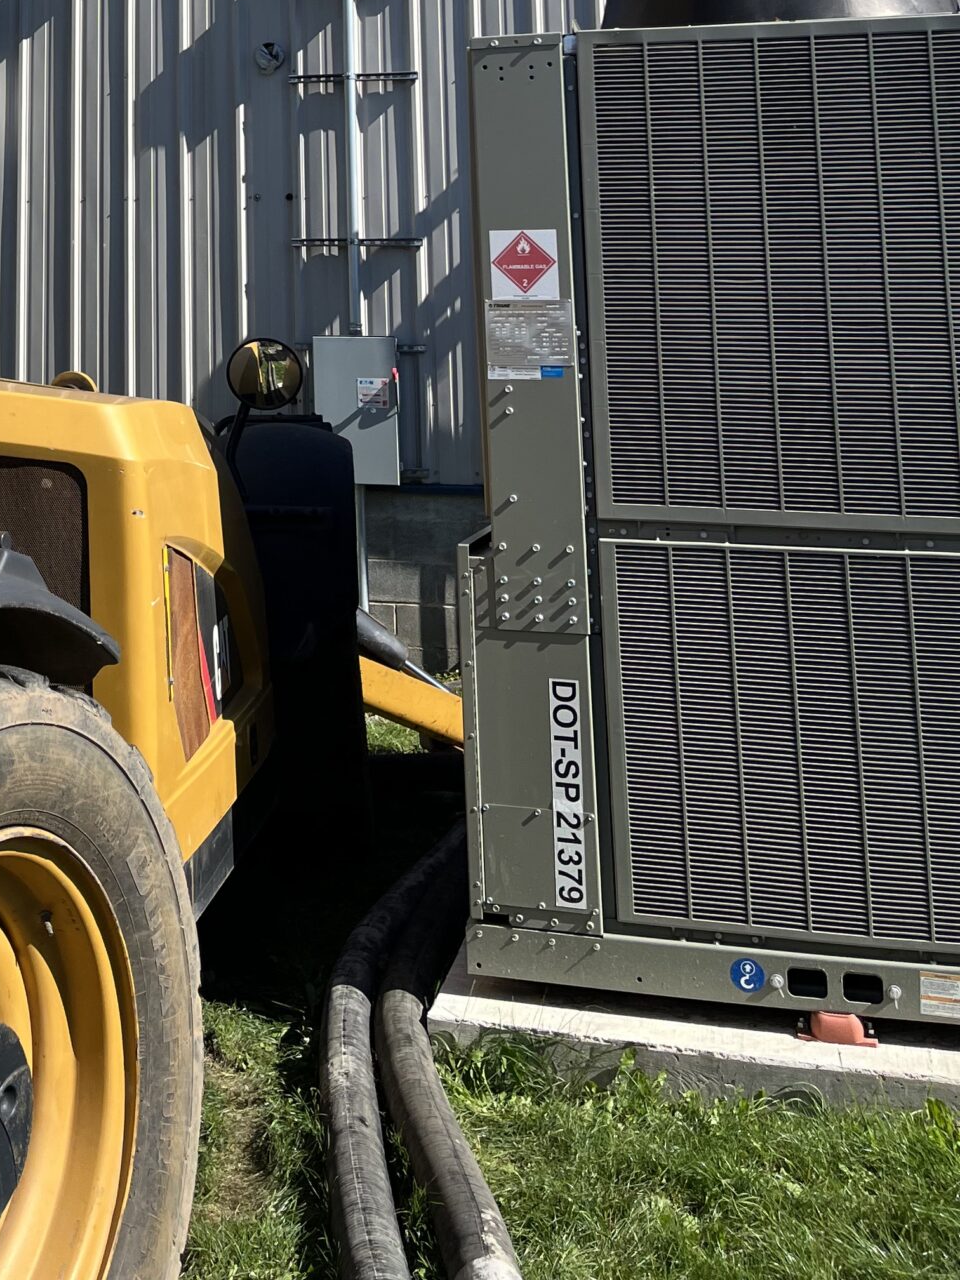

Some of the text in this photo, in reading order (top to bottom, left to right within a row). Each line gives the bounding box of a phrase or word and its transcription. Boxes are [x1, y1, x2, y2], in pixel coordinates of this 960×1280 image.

[522, 278, 529, 287] 2
[212, 613, 231, 701] CAT
[551, 680, 584, 904] DOT-SP 21379
